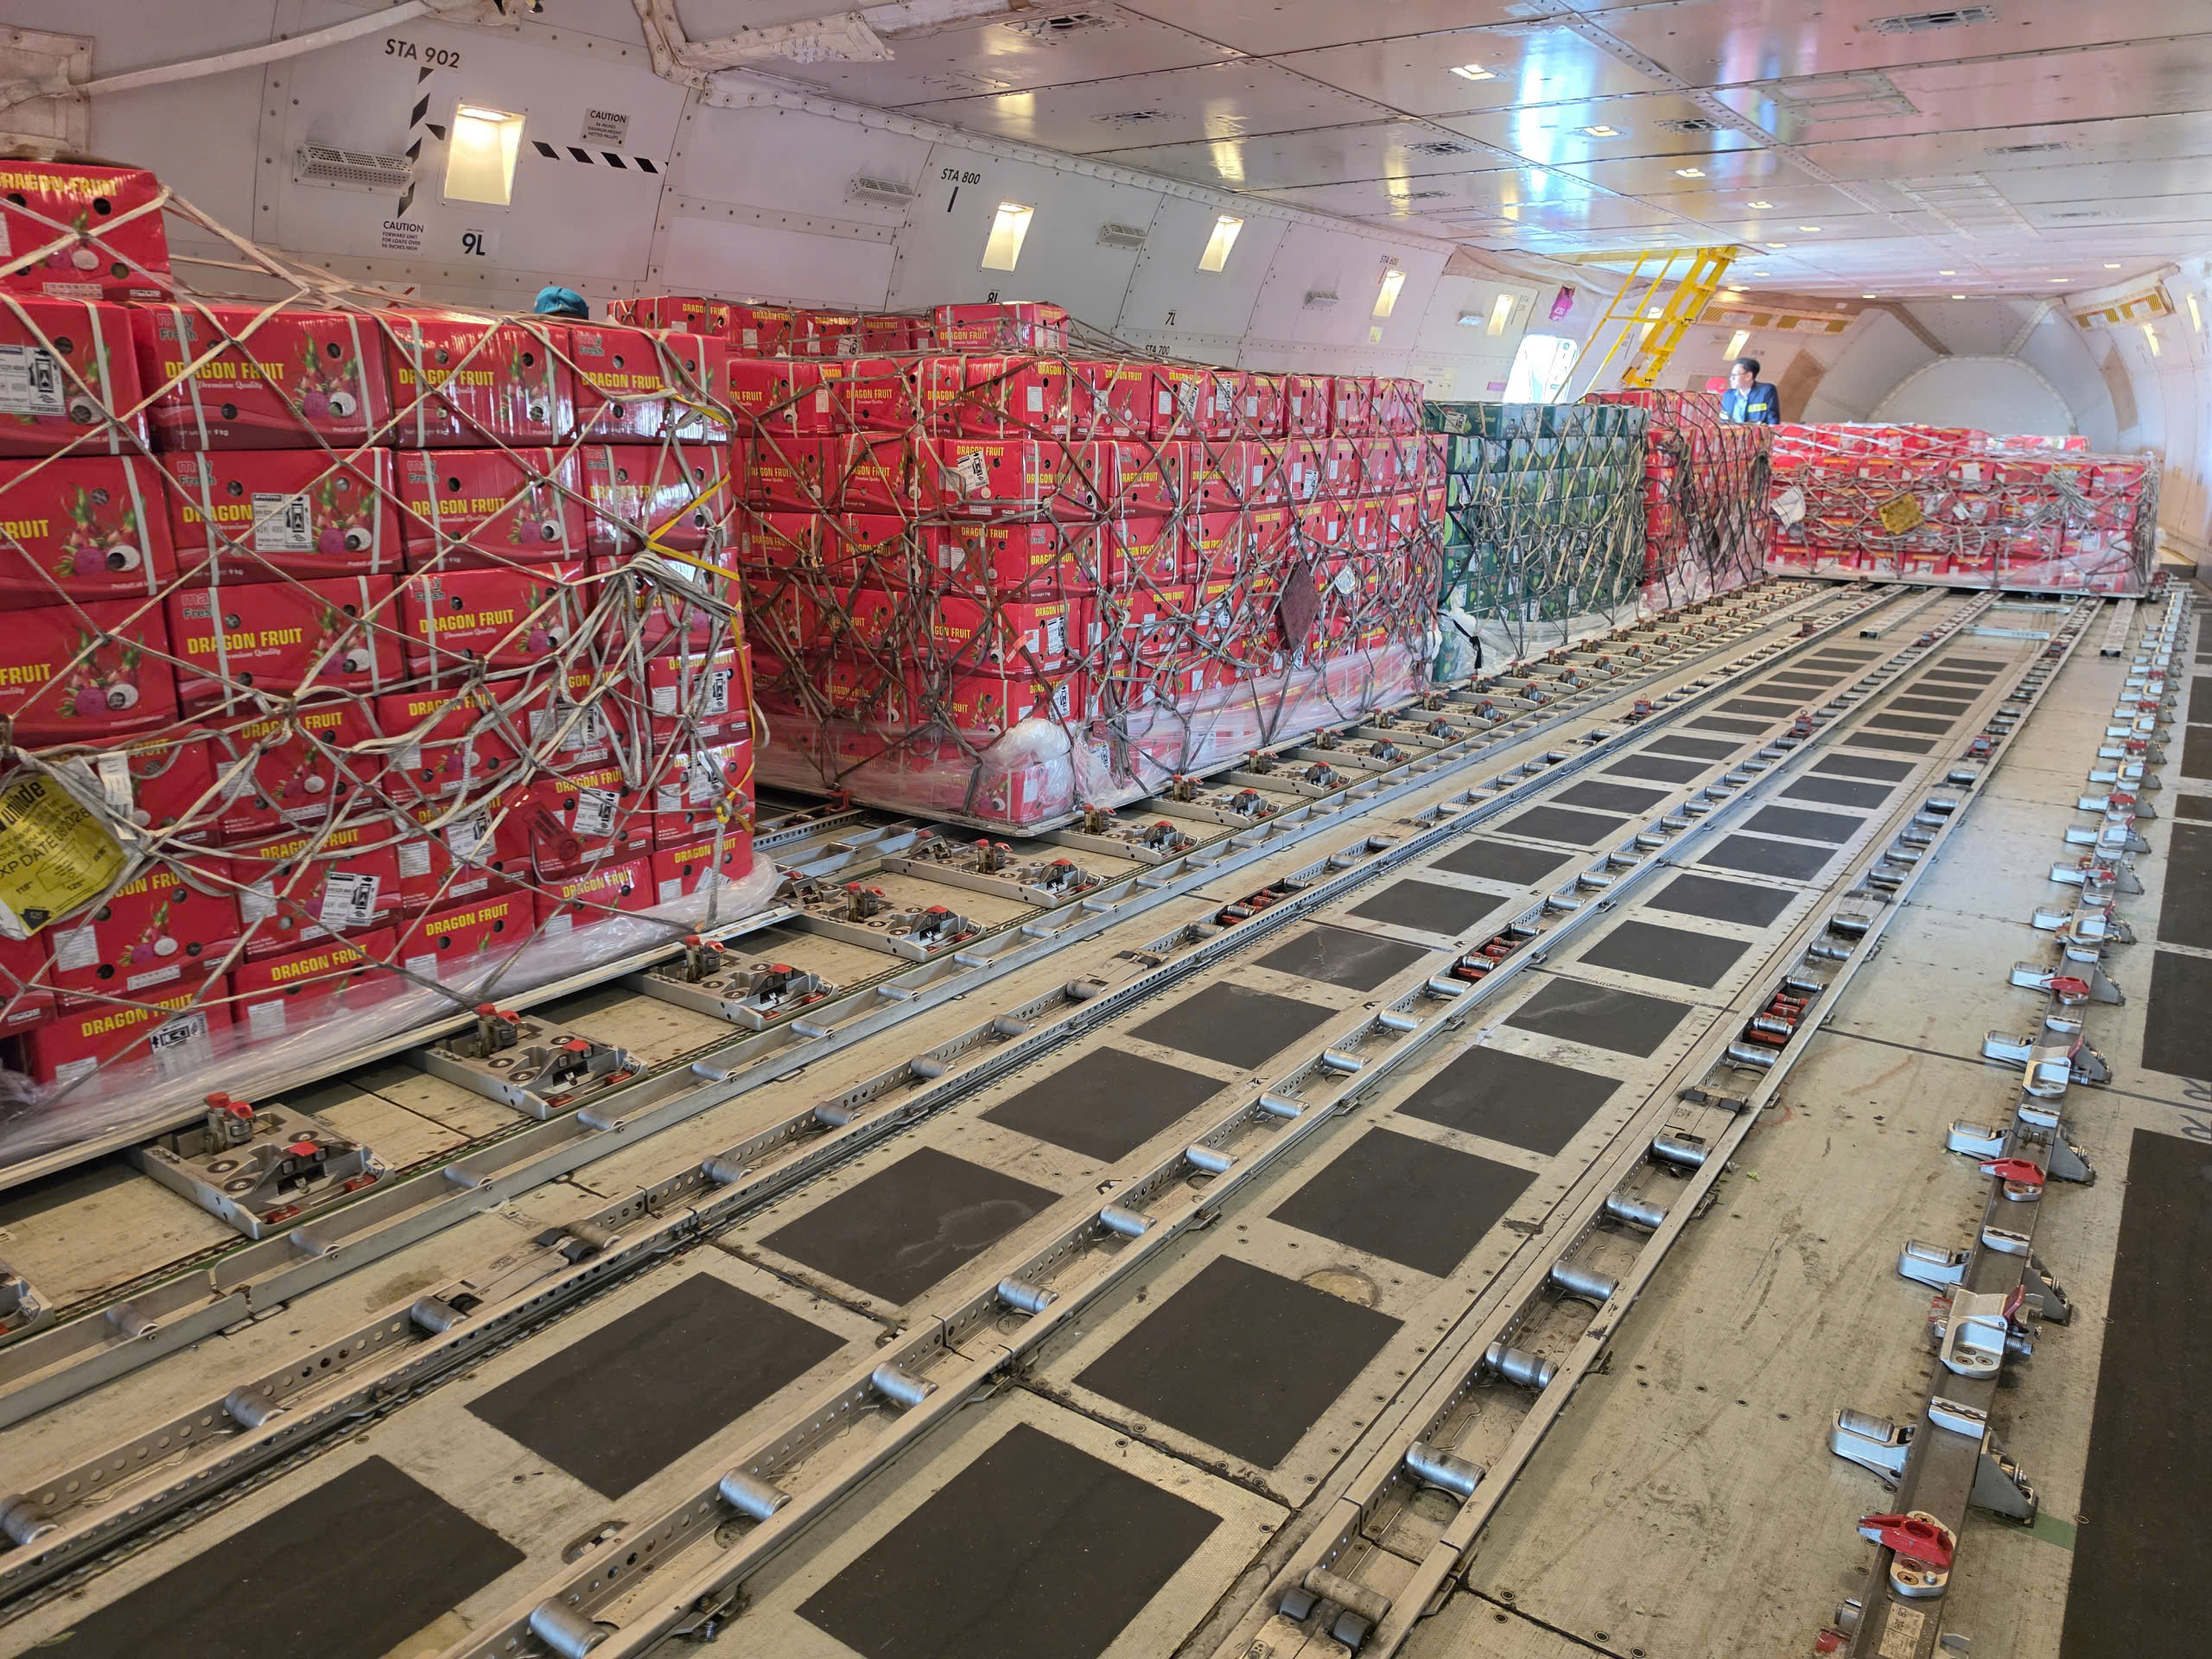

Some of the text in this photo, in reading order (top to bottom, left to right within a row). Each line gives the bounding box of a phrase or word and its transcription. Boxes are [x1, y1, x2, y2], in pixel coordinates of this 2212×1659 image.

[385, 38, 460, 68] STA 902
[589, 110, 626, 124] CAUTION
[940, 168, 982, 186] STA 800
[383, 220, 424, 233] CAUTION
[461, 232, 486, 256] 9L
[753, 310, 777, 320] DRAGON
[1165, 311, 1176, 326] 7L
[969, 331, 988, 340] FRUIT
[1158, 346, 1170, 354] 700
[241, 361, 284, 380] FRUIT
[1038, 365, 1061, 375] DRAGON
[1128, 372, 1142, 380] FRUIT
[460, 369, 495, 386] FRUIT
[631, 375, 662, 390] FRUIT
[236, 381, 263, 390] Quality
[742, 391, 763, 401] FRUIT
[874, 389, 893, 399] FRUIT
[985, 447, 1004, 456] FRUIT
[1143, 472, 1158, 481] FRUIT
[472, 495, 506, 513] FRUIT
[990, 529, 1009, 538] FRUIT
[1172, 591, 1185, 601] FRUIT
[480, 609, 514, 627] FRUIT
[1035, 606, 1057, 617] DRAGON
[260, 627, 302, 647] FRUIT
[951, 627, 971, 639] FRUIT
[255, 648, 281, 657] Quality
[304, 711, 343, 731] FRUIT
[556, 774, 598, 794] DRAGON
[19, 835, 59, 868] DATE
[674, 843, 712, 865] DRAGON
[425, 901, 510, 938] DRAGON FRUIT
[270, 944, 368, 982] DRAGON FRUIT
[81, 1007, 149, 1038] DRAGON
